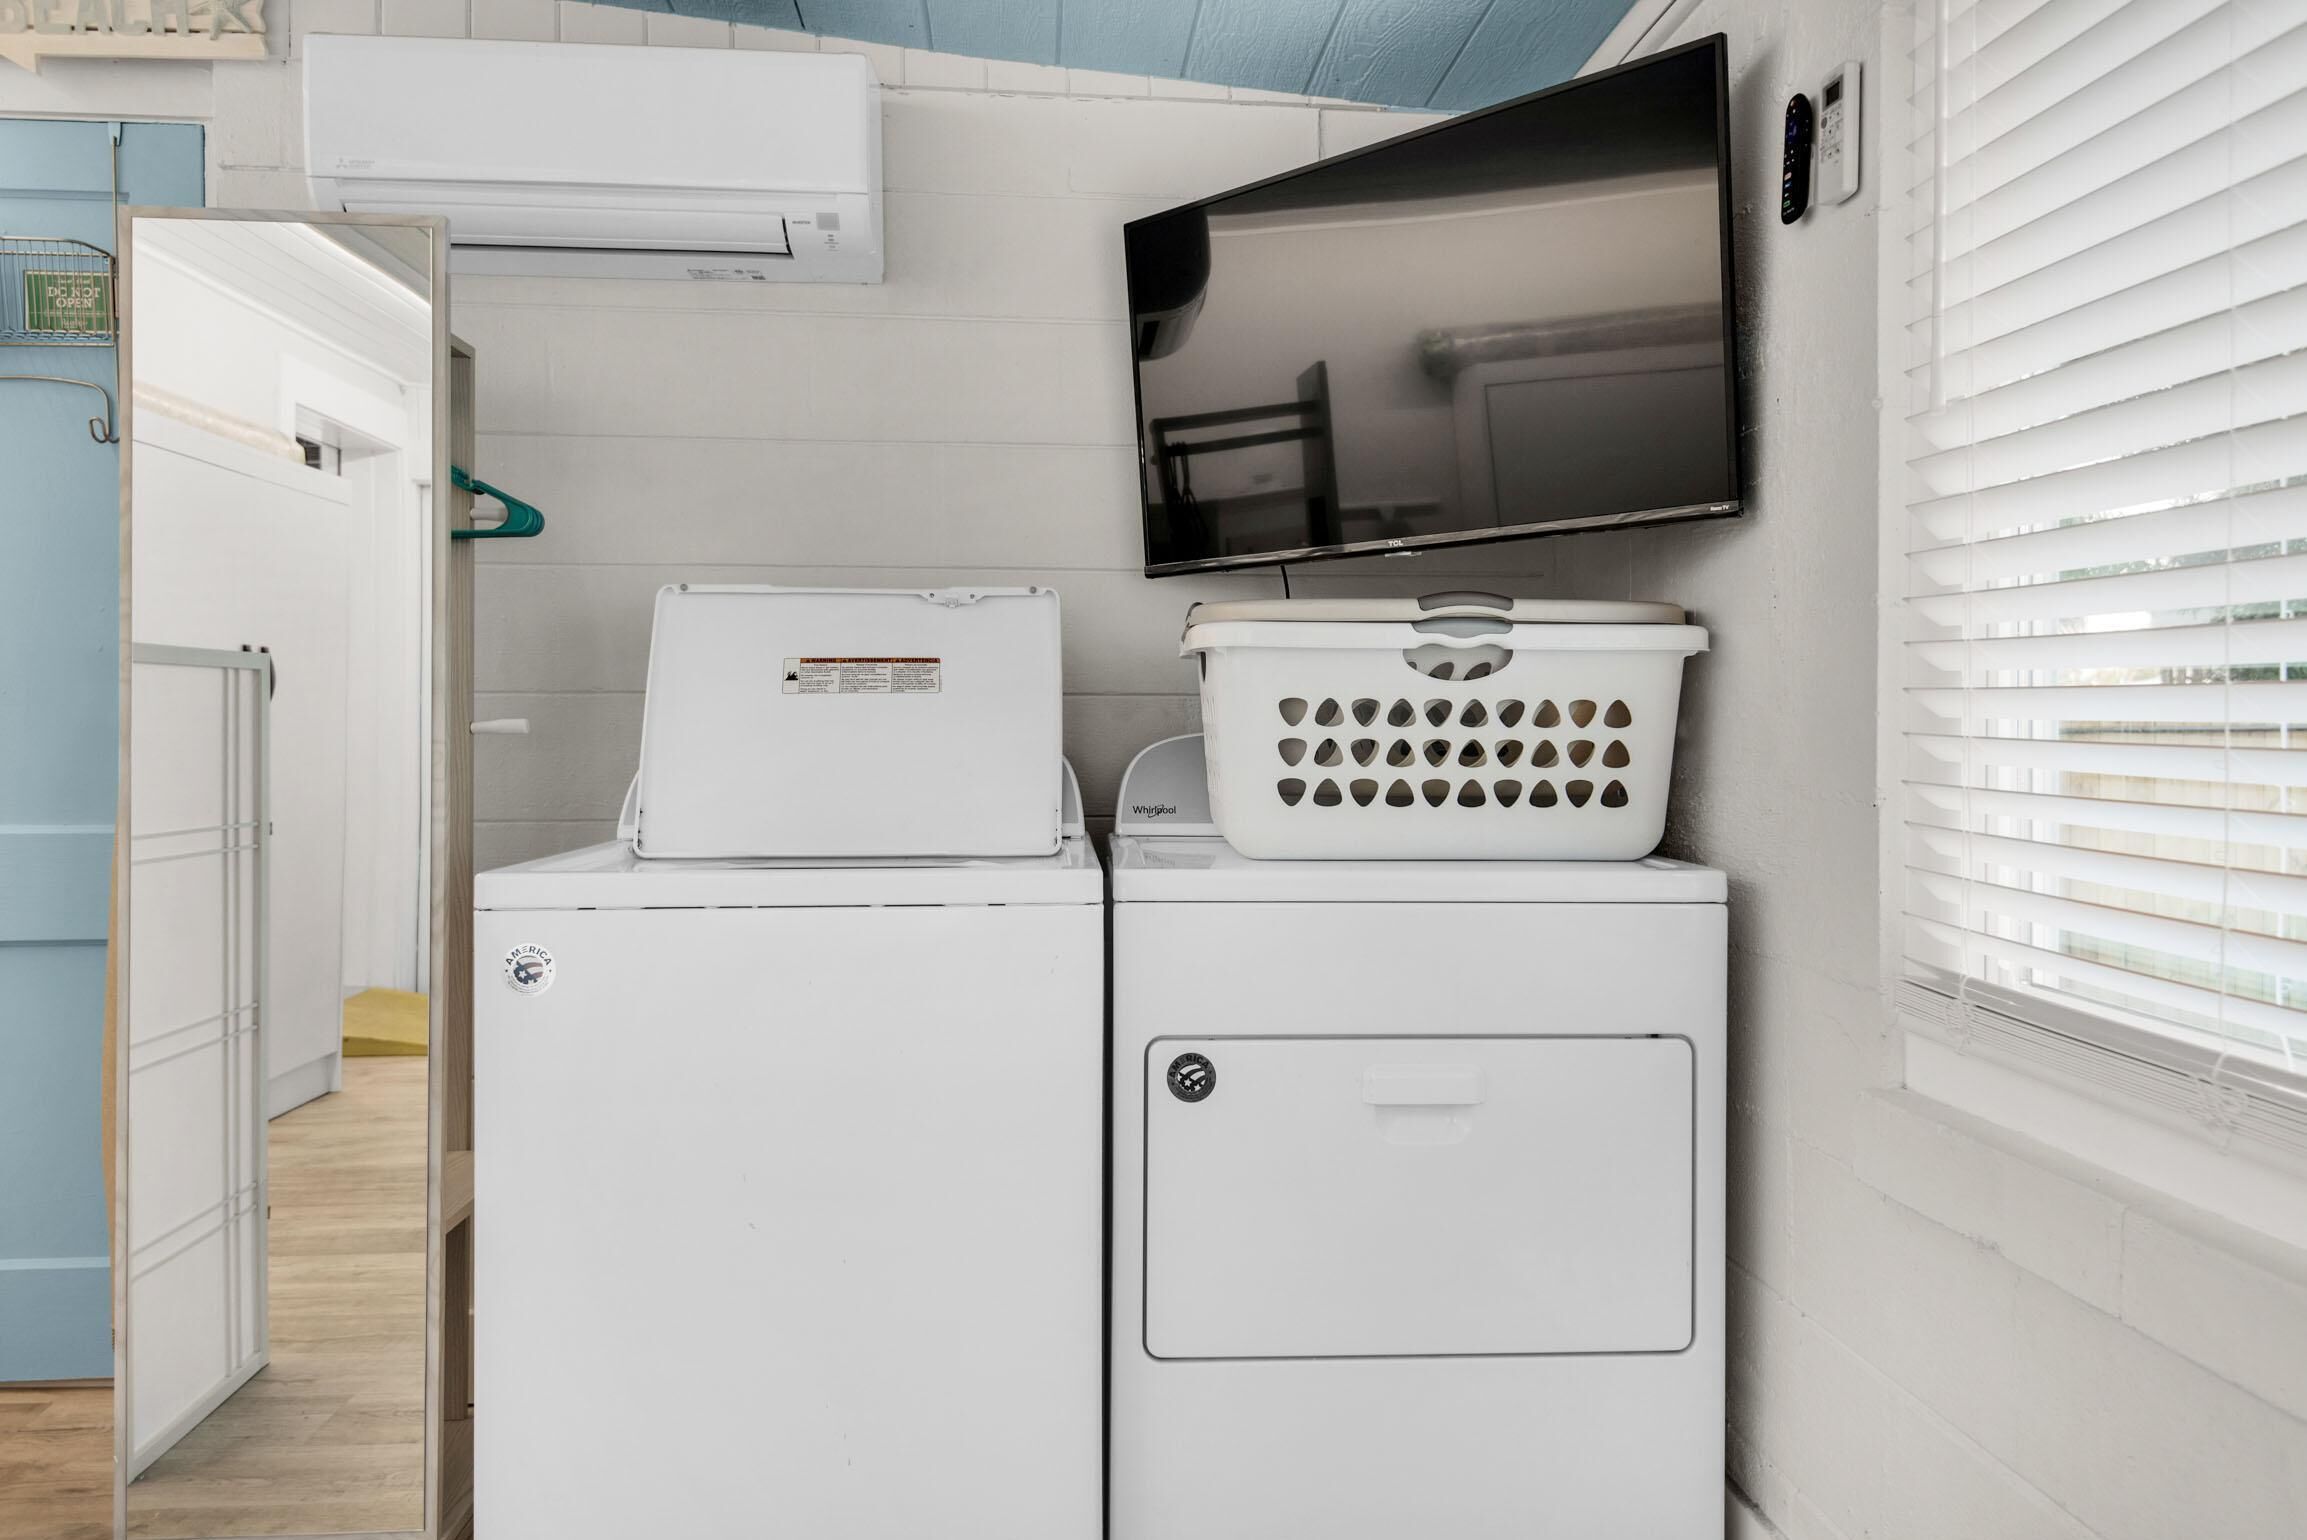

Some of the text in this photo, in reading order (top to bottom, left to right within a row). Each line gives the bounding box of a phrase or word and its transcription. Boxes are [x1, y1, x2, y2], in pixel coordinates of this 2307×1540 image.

[47, 286, 101, 298] DO NOT
[56, 297, 92, 308] OPEN
[1133, 805, 1177, 817] Whirlpool
[506, 945, 552, 966] AMERICA
